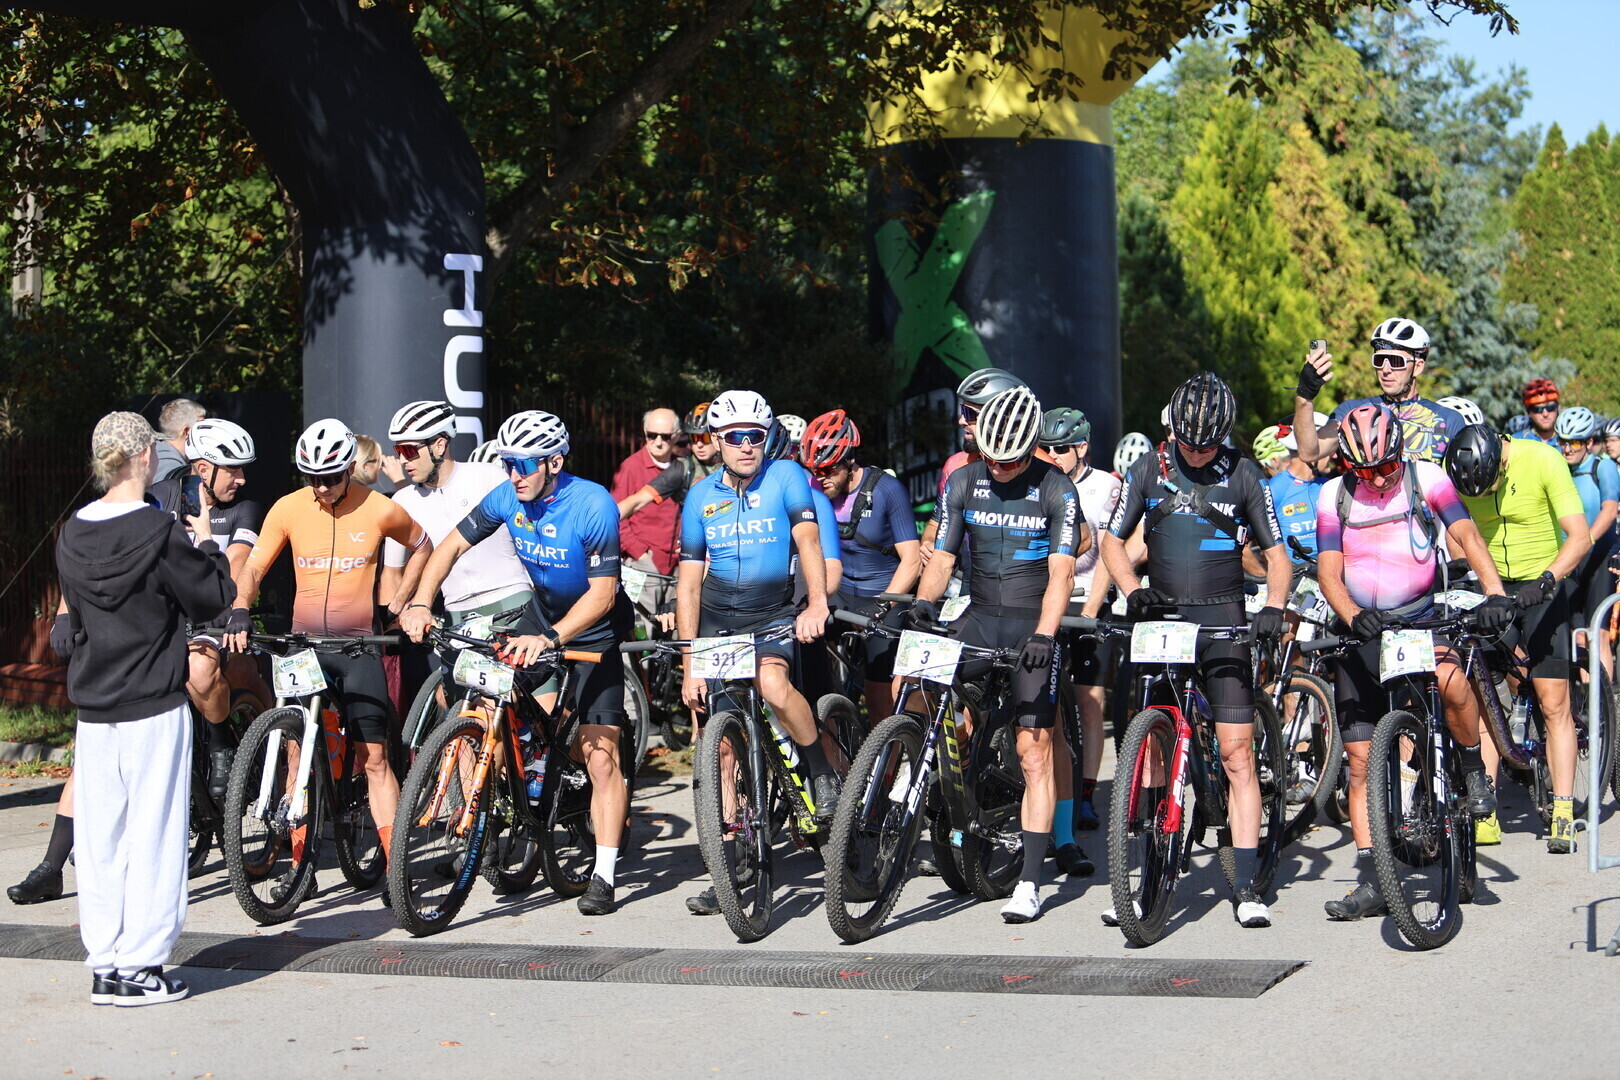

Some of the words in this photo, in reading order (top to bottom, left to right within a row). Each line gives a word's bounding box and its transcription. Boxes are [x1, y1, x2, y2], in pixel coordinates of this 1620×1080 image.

[204, 451, 218, 460] POC
[973, 488, 991, 498] HX
[1110, 480, 1130, 531] MOVLINK
[1264, 485, 1282, 541] MOVLINK
[936, 490, 949, 540] MOVLINK
[973, 511, 1047, 529] MOVLINK
[1061, 498, 1076, 546] MOVLINK
[706, 517, 776, 540] START
[515, 537, 569, 560] START
[461, 627, 472, 638] 16
[1161, 634, 1168, 649] 1
[712, 652, 736, 667] 321
[920, 650, 931, 665] 3
[1397, 646, 1405, 661] 6
[1049, 642, 1061, 696] MOVLINK
[289, 673, 299, 686] 2
[479, 672, 487, 686] 5
